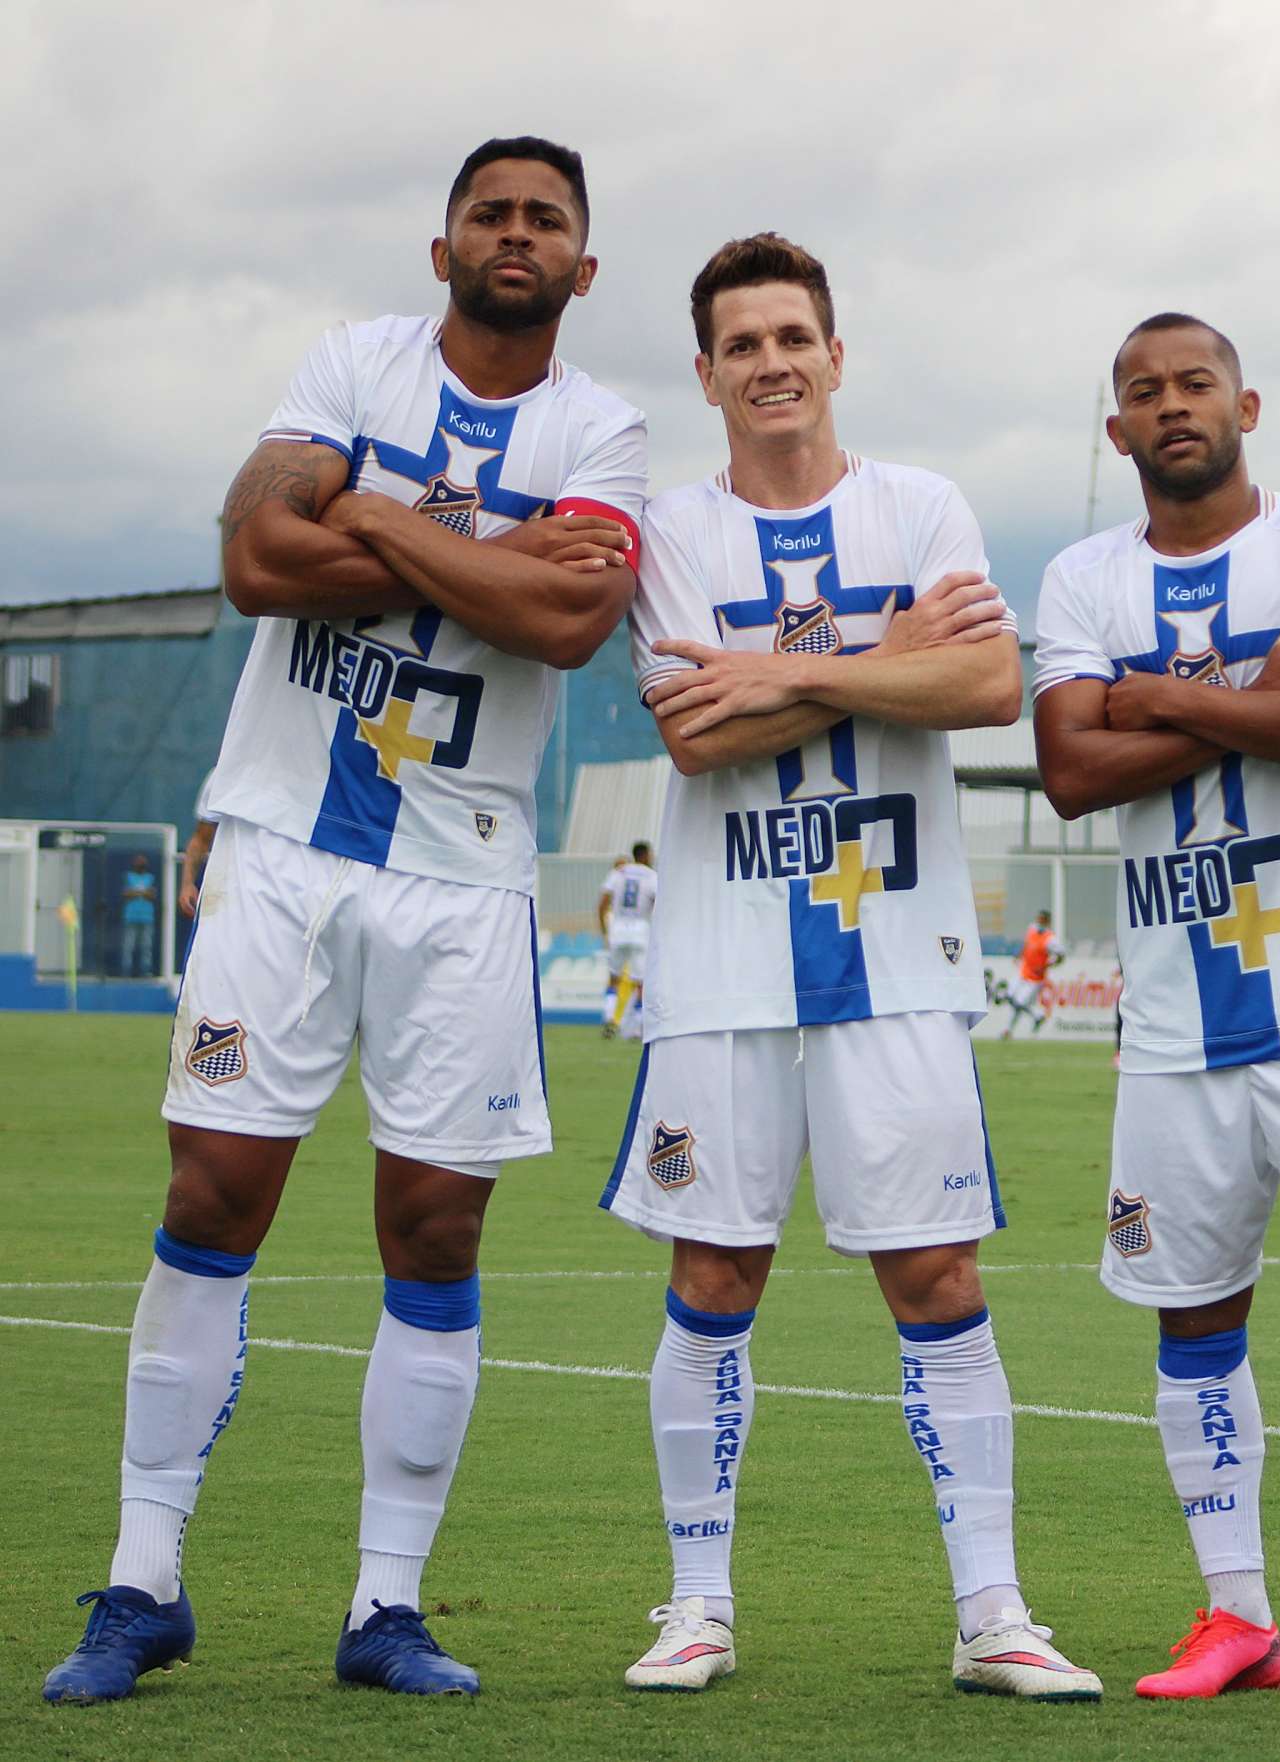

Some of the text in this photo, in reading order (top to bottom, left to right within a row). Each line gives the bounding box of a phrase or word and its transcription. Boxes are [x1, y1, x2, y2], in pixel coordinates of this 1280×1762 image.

[448, 409, 497, 439] Karilu
[773, 534, 821, 550] Karilu
[1167, 583, 1216, 601] Karilu
[714, 1412, 743, 1494] SANTA
[904, 1403, 955, 1481] SANTA
[1197, 1387, 1242, 1471] SANTA
